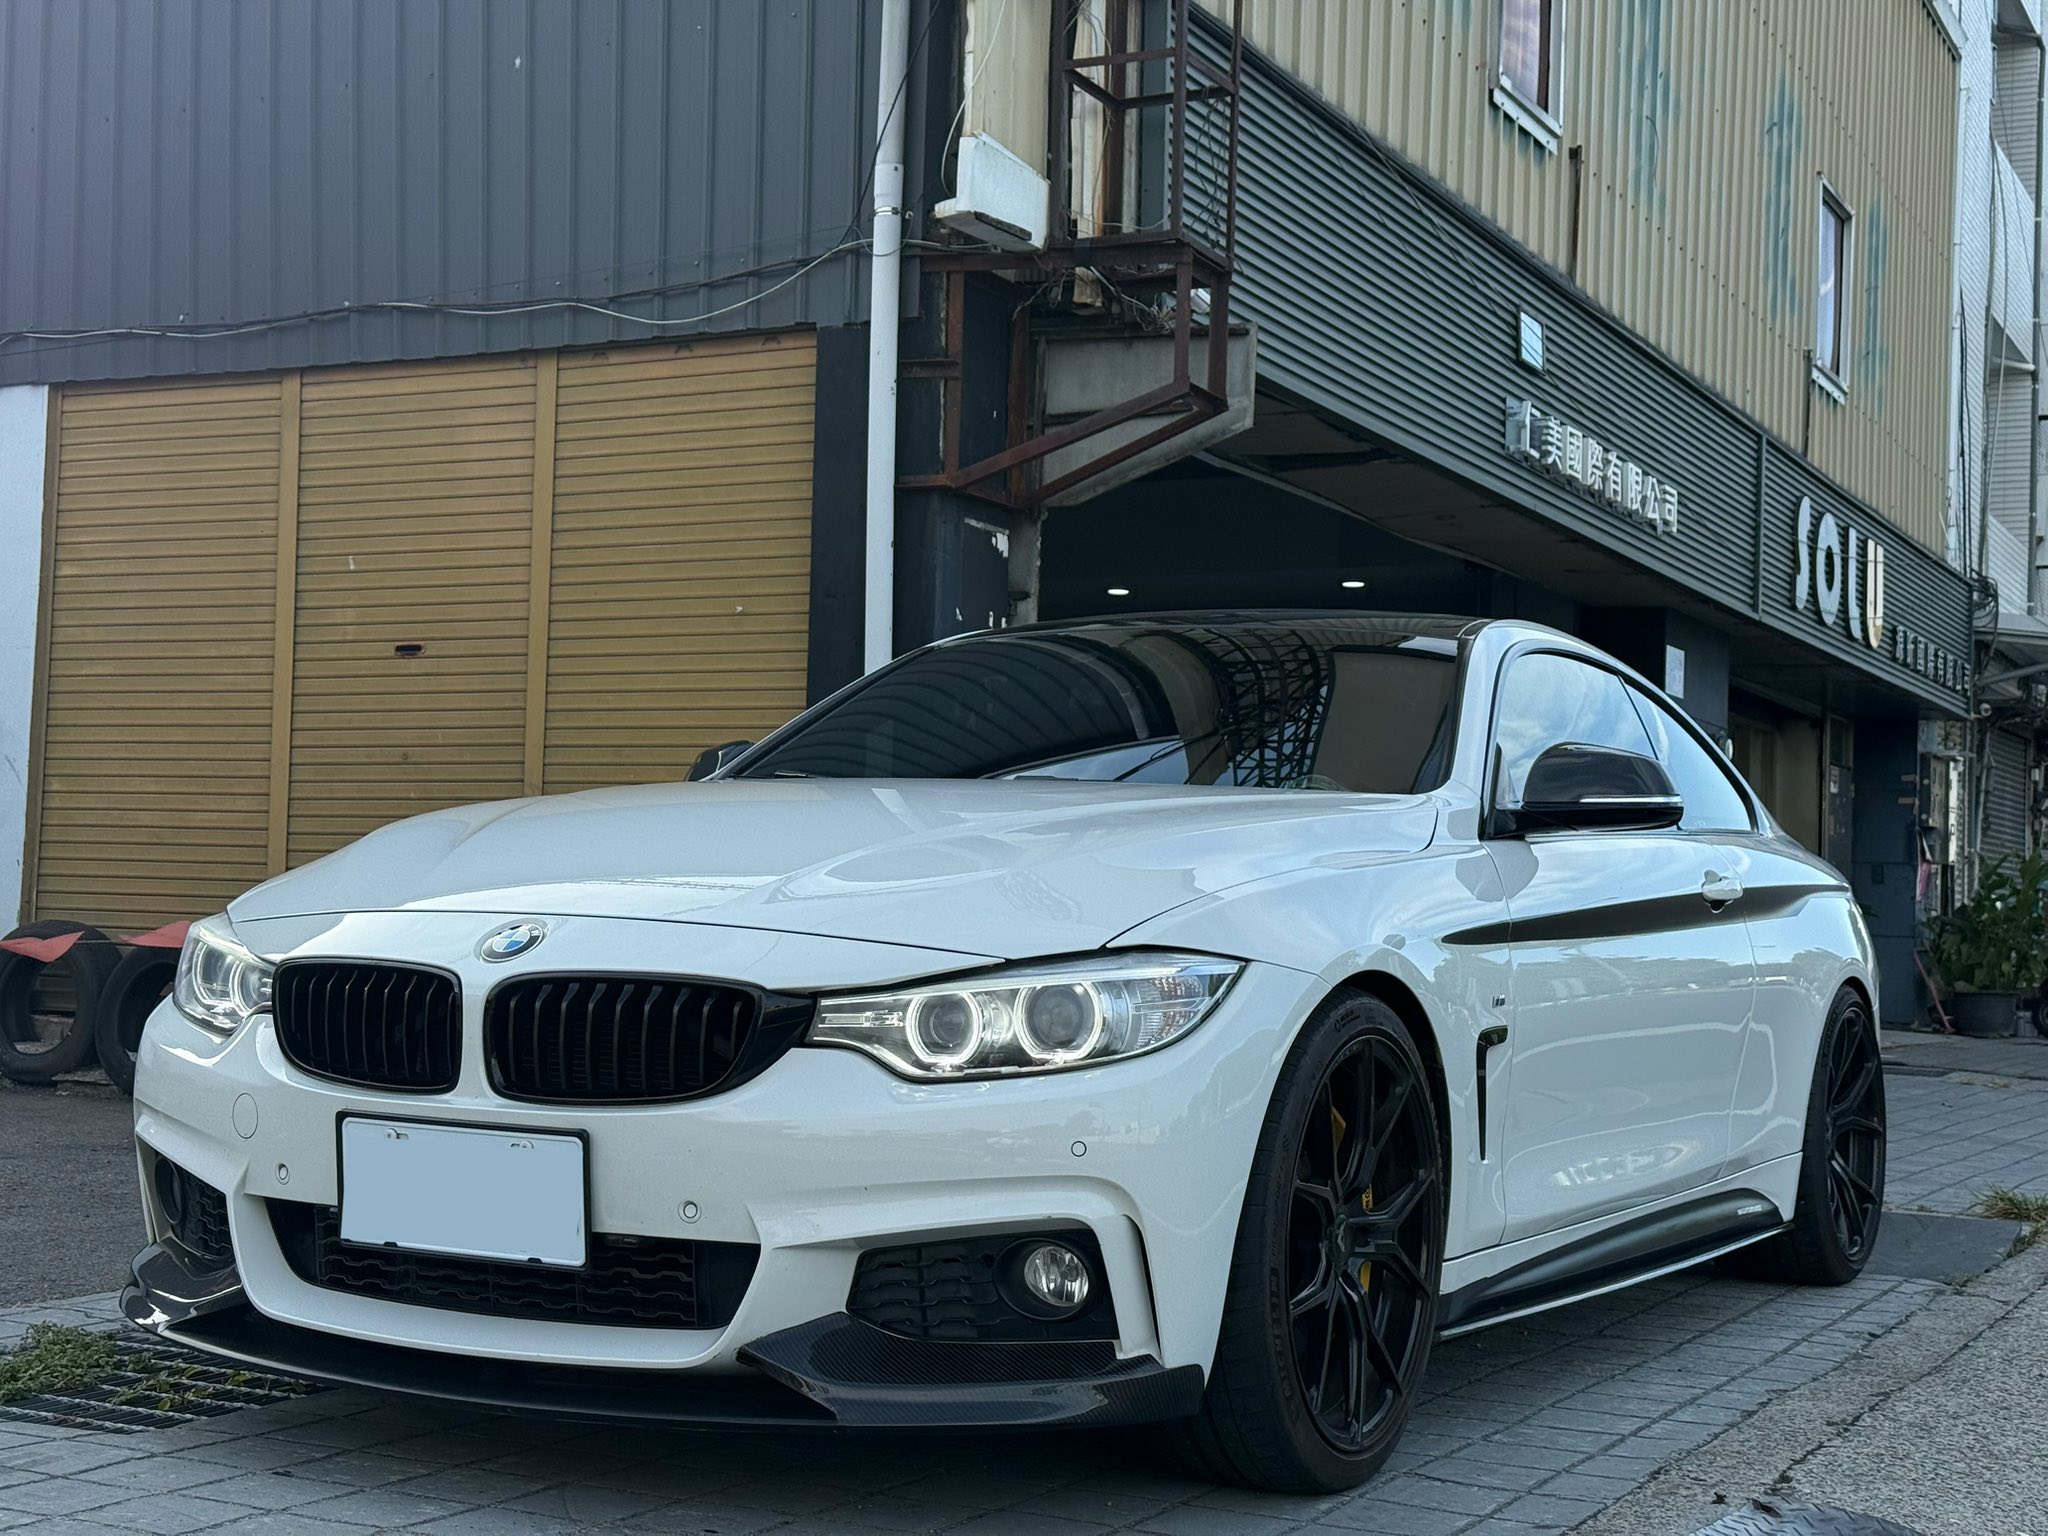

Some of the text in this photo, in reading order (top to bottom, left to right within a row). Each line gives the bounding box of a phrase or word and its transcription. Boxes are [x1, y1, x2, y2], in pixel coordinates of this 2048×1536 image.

[1518, 400, 1678, 534] 仁美國際有限公司
[1795, 495, 1884, 649] SOLU
